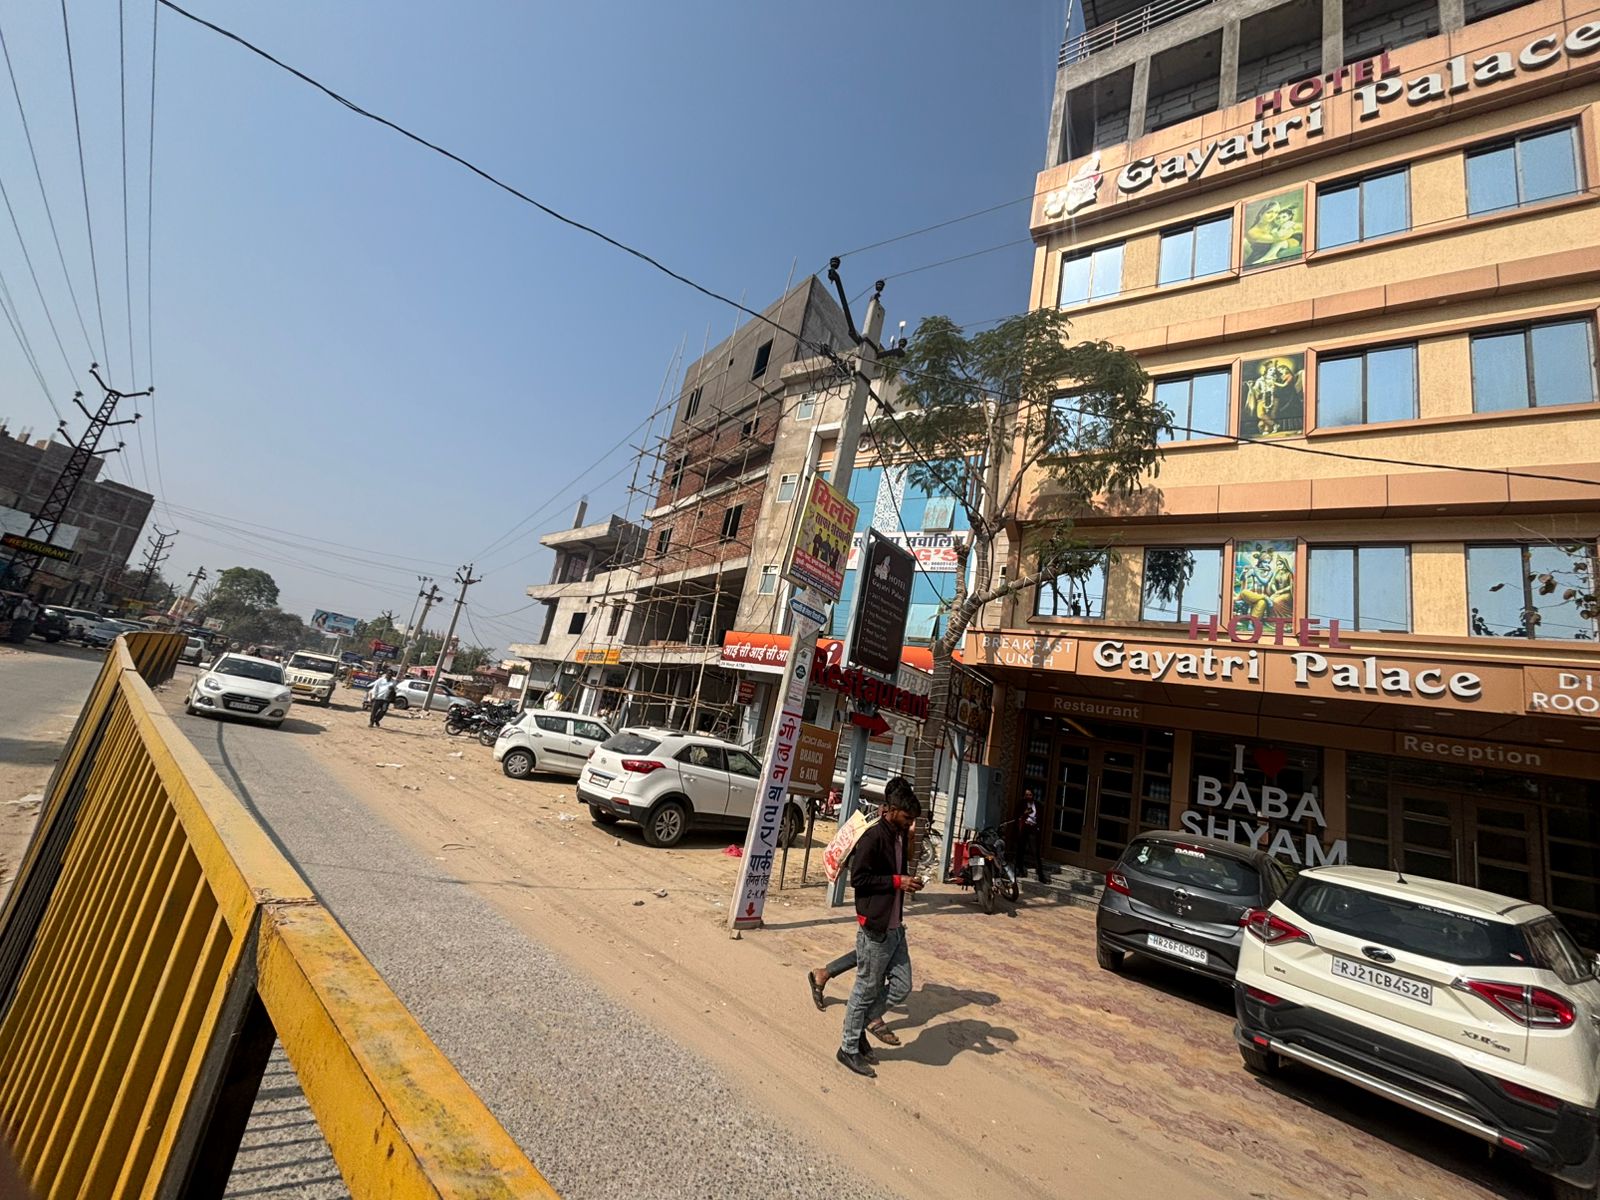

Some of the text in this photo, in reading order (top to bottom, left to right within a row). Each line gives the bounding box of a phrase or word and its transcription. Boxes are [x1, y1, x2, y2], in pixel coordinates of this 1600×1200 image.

[1255, 51, 1401, 119] HOTEL
[1117, 23, 1600, 193] Gayatri Palace
[982, 636, 1073, 654] BREAKFAST
[1188, 613, 1351, 649] HOTEL
[723, 641, 739, 659] आई
[749, 644, 767, 661] आई
[996, 651, 1054, 667] LUNCH
[810, 646, 929, 720] Restaurant
[1093, 640, 1483, 700] Gayatri Palace
[1053, 696, 1140, 719] Restaurant
[800, 748, 823, 764] BRANCH
[1233, 744, 1245, 774] I
[1403, 735, 1542, 766] Reception
[805, 767, 818, 781] ATM
[1197, 775, 1327, 827] BABA
[1180, 810, 1348, 867] SHYAM
[1340, 962, 1430, 1000] RJ21CB4528
